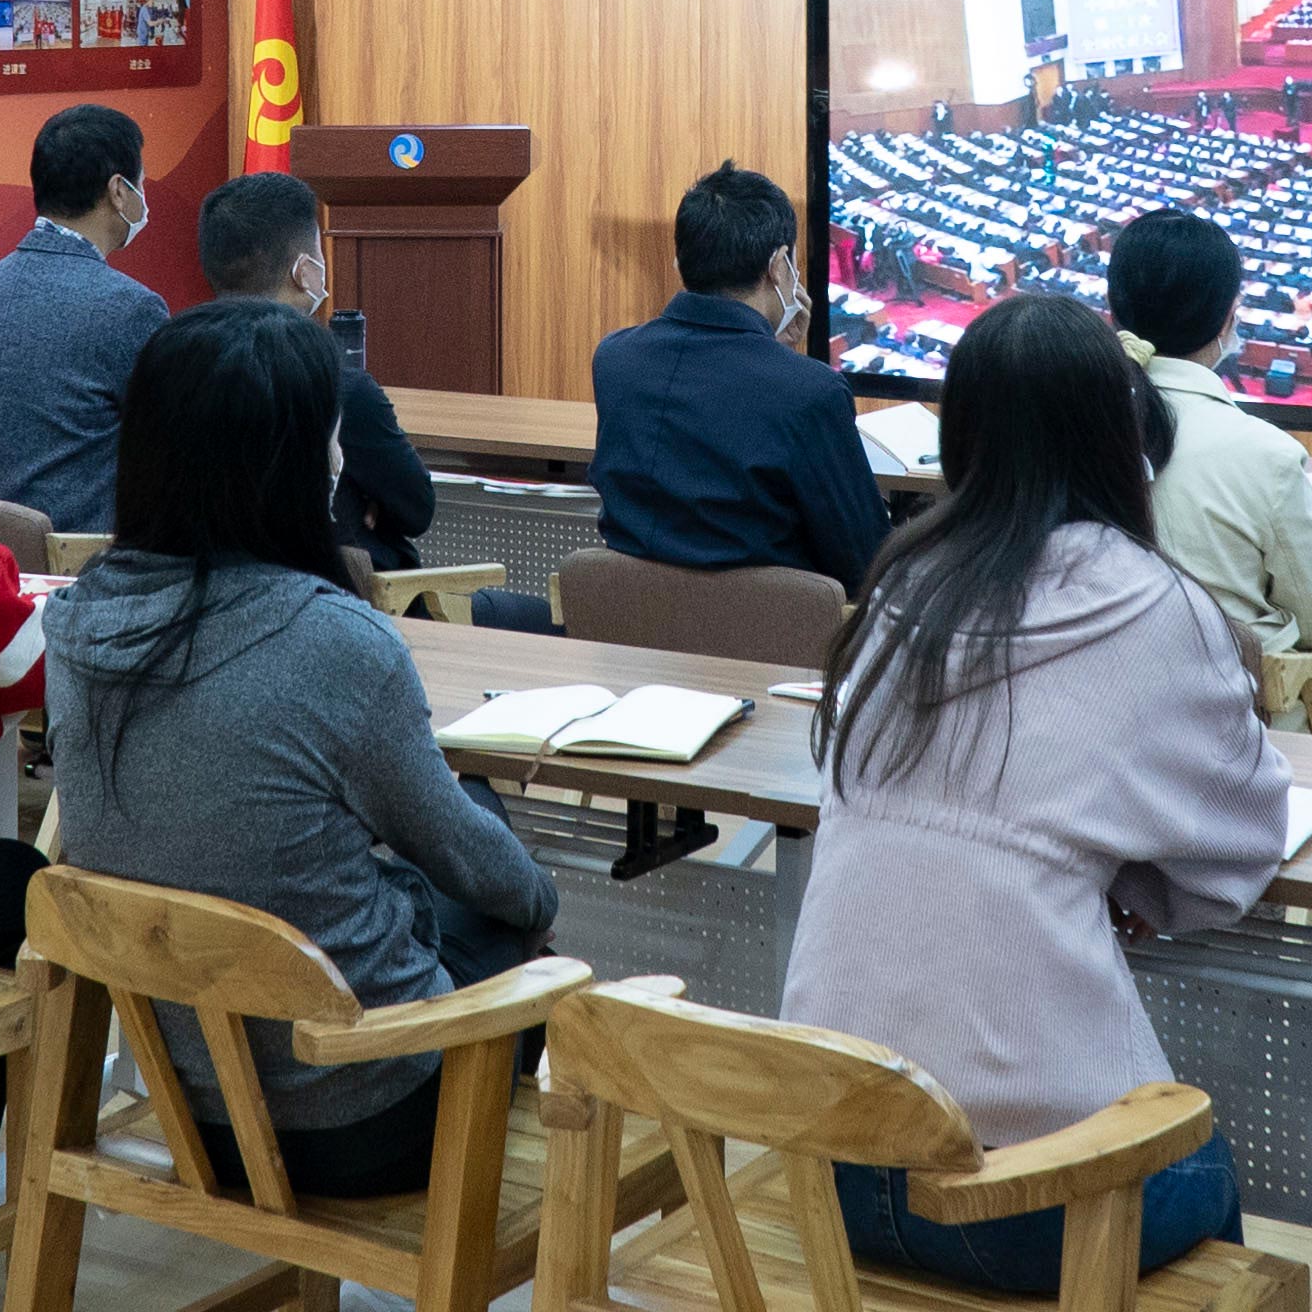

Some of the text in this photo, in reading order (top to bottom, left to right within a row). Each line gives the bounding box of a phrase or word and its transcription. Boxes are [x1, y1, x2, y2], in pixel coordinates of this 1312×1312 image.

[2, 63, 27, 75] 进课堂
[130, 59, 152, 71] 进企业
